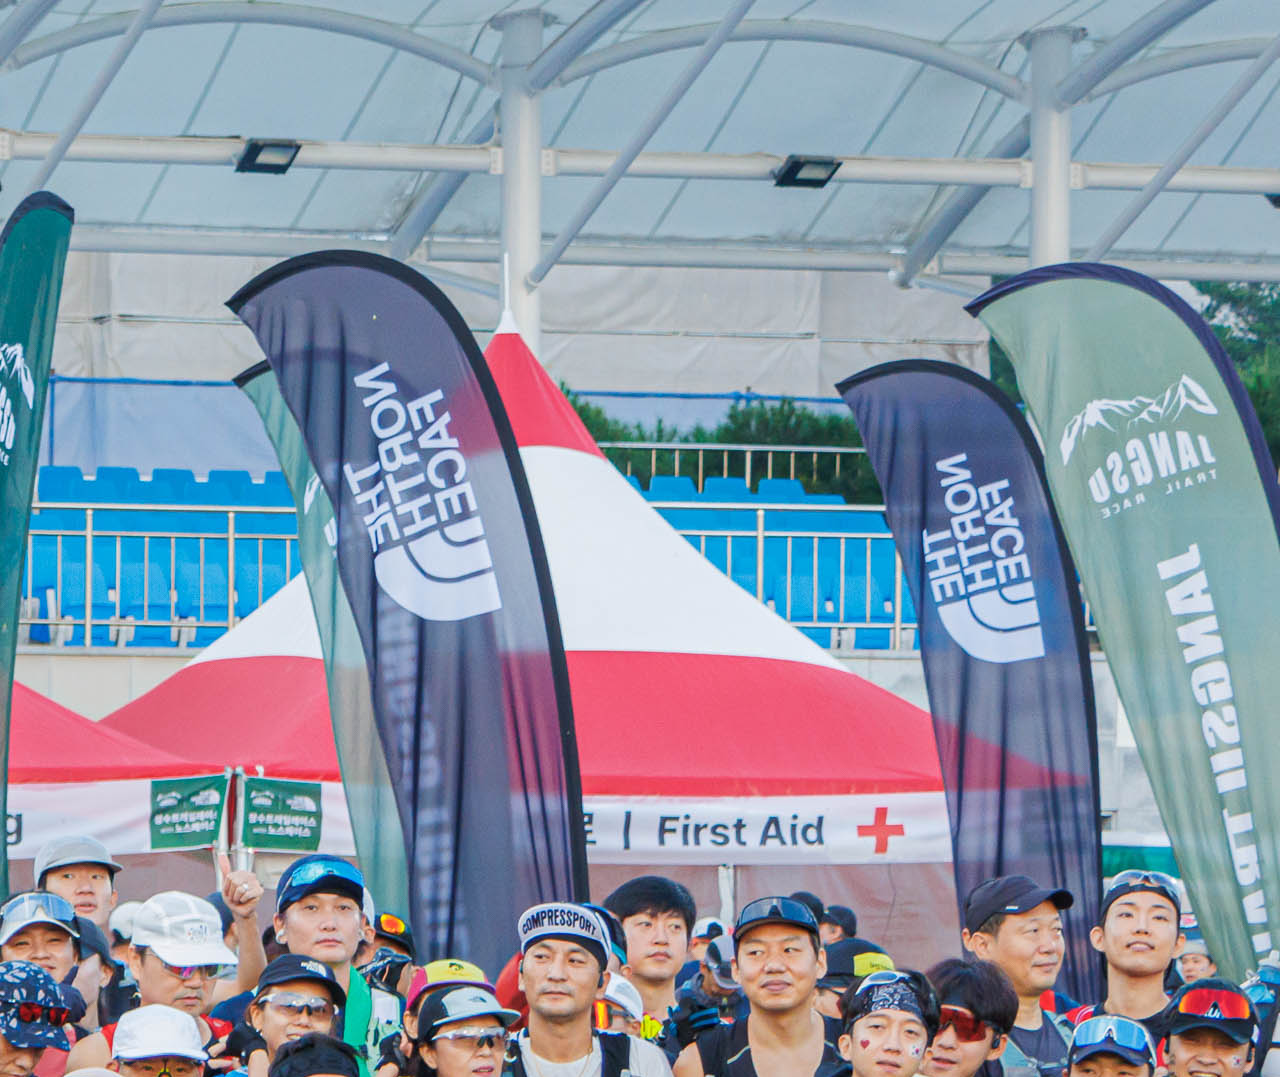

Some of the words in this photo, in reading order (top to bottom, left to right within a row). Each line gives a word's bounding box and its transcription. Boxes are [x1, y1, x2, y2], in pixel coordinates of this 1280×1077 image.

[657, 814, 747, 848] First
[759, 813, 826, 847] Aid
[522, 906, 597, 936] COMPRESSPORT
